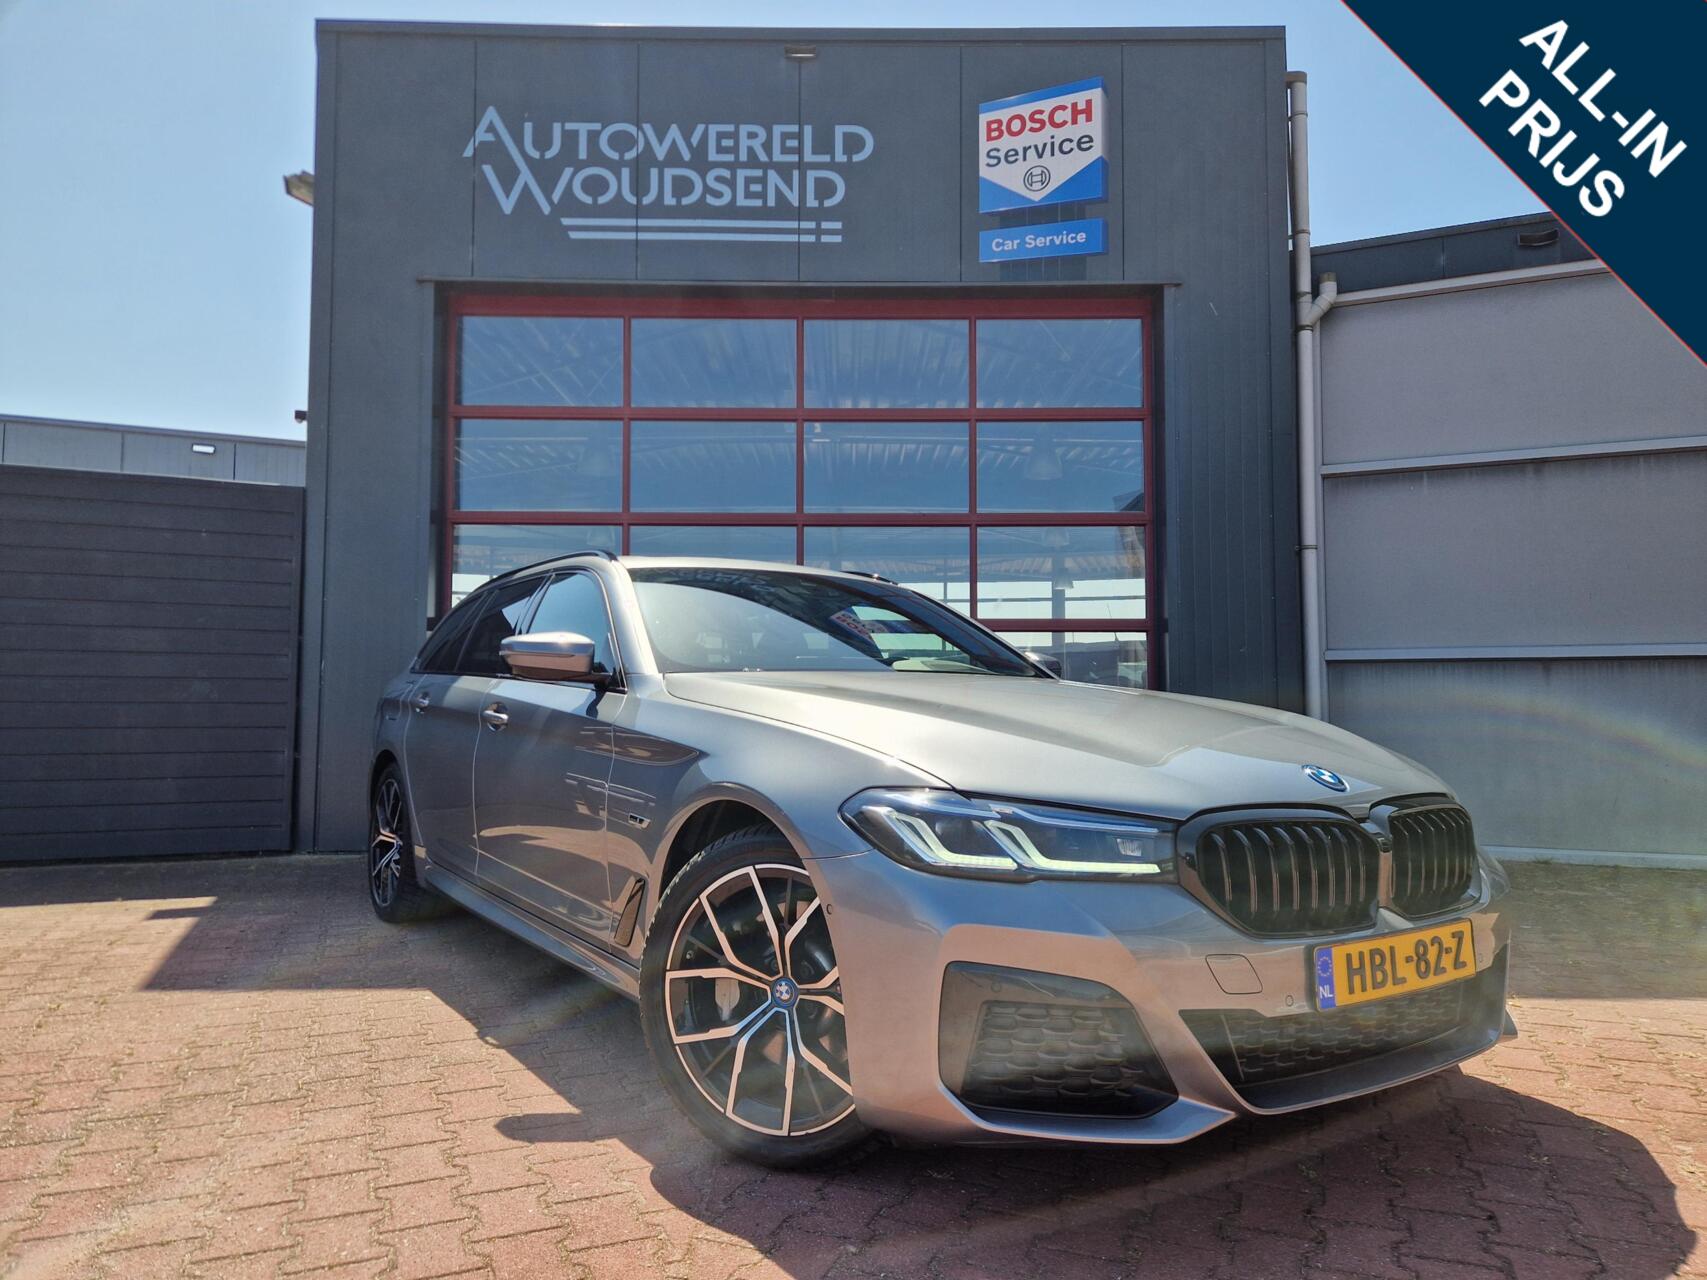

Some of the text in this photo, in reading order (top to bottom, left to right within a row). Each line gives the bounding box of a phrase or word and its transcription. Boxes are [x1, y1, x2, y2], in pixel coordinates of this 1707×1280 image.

[462, 105, 875, 163] AUTOWERELD
[985, 98, 1093, 142] BOSCH
[985, 133, 1094, 168] Service
[481, 163, 846, 215] WOUDSEND
[991, 230, 1087, 252] Car Service
[1345, 930, 1467, 995] HBL-82-Z
[1319, 985, 1334, 999] NL
